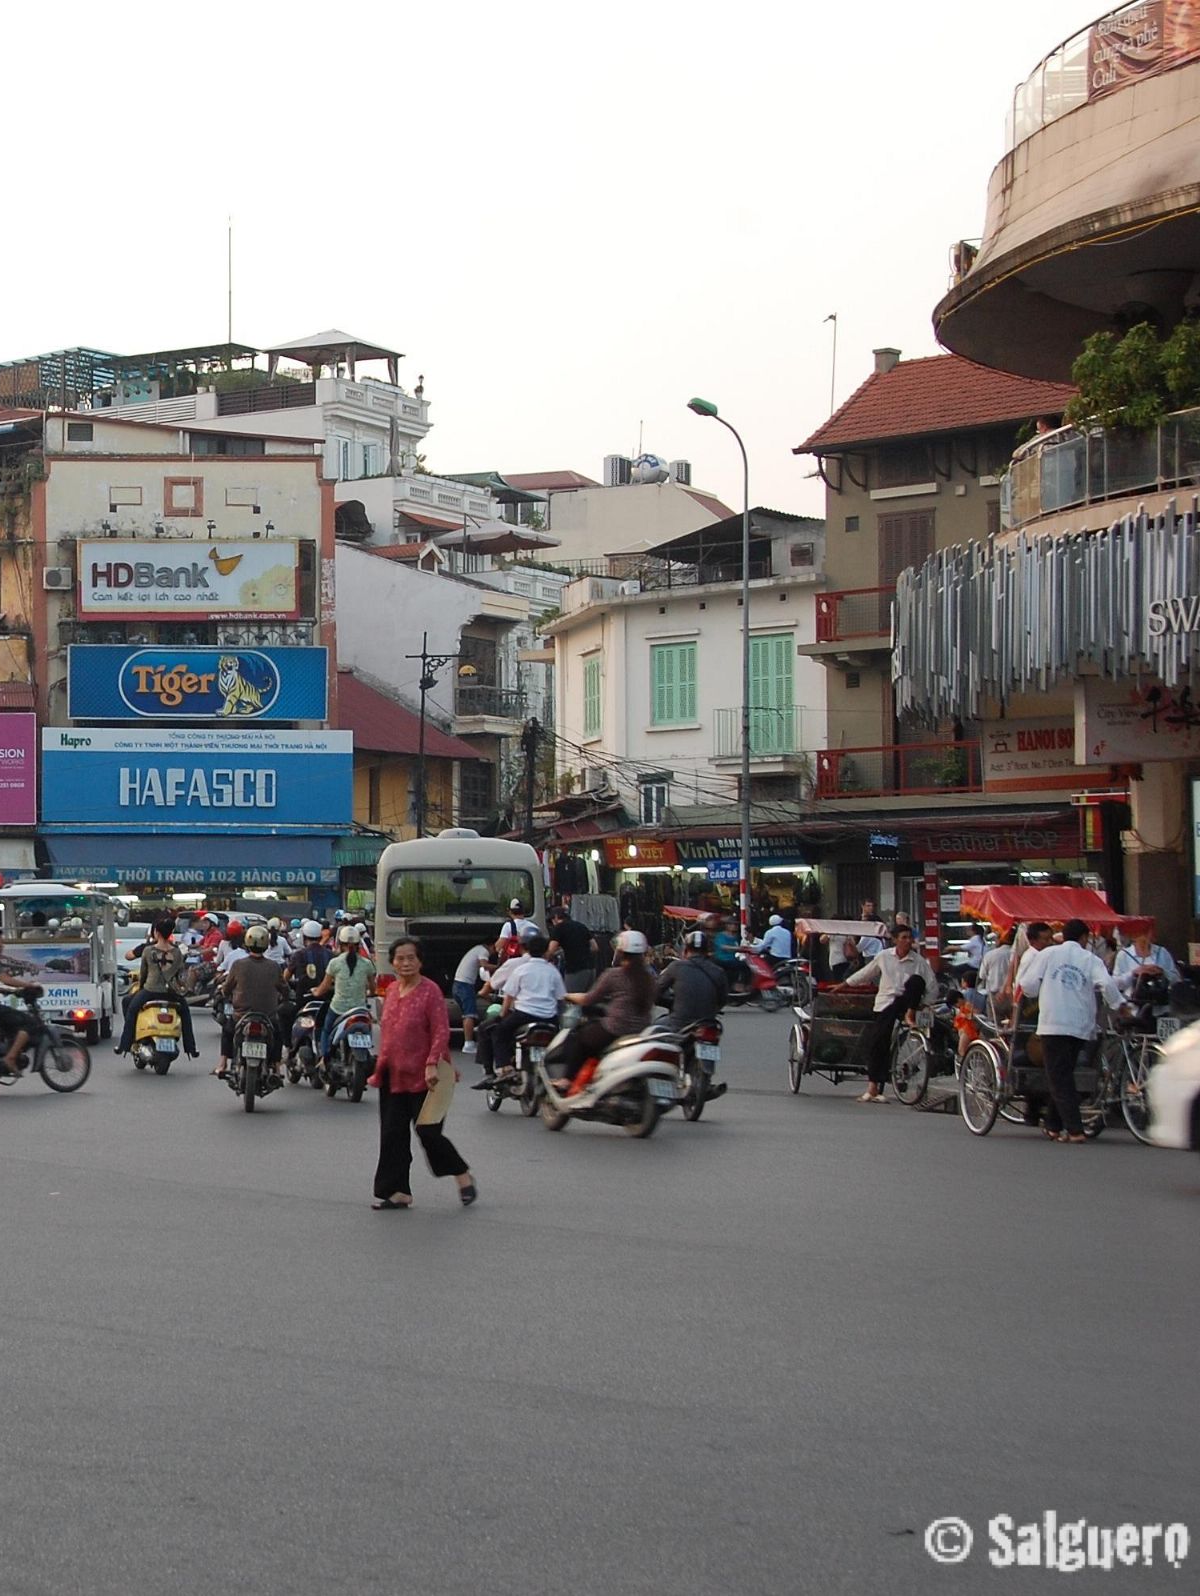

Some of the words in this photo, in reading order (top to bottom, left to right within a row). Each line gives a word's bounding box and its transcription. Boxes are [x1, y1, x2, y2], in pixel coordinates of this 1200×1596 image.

[91, 562, 210, 589] HDBank
[92, 592, 112, 601] Cam
[132, 664, 217, 706] Tiger
[60, 733, 91, 748] Hapro
[1017, 729, 1056, 752] HANOI
[1057, 727, 1075, 749] SO
[119, 767, 276, 808] HAFASCO
[676, 841, 719, 859] Vinh
[927, 832, 1001, 853] Leather
[56, 866, 108, 876] HAFASCO
[115, 867, 151, 882] THỜI
[156, 869, 205, 882] TRANG
[209, 871, 236, 882] 102
[241, 867, 281, 883] HÀNG
[286, 868, 316, 883] ĐÀO
[48, 988, 78, 998] XANH
[40, 998, 91, 1007] OURISM
